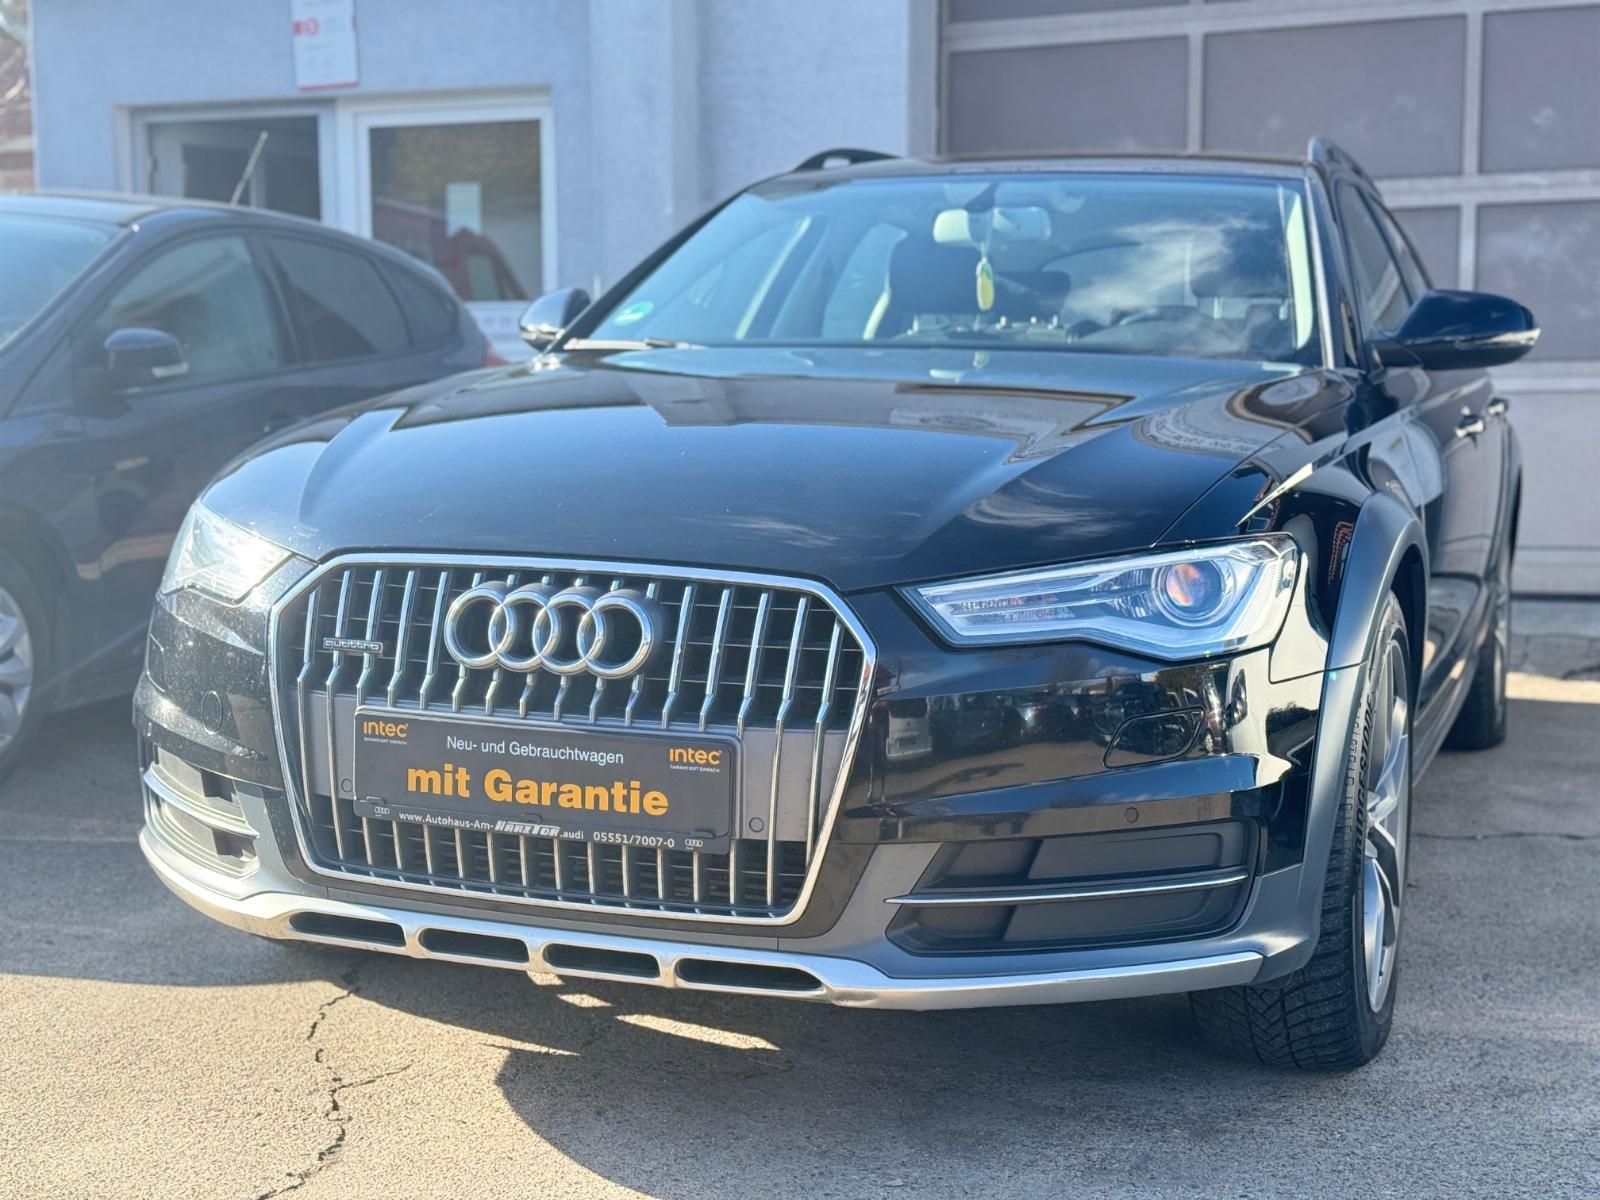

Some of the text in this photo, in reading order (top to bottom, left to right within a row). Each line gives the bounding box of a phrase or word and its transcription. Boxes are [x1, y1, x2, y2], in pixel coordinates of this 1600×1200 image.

[447, 735, 624, 766] Neu- und Gebrauchtwagen
[407, 763, 669, 816] mit Garantie
[593, 831, 675, 848] 05551/7007-0
